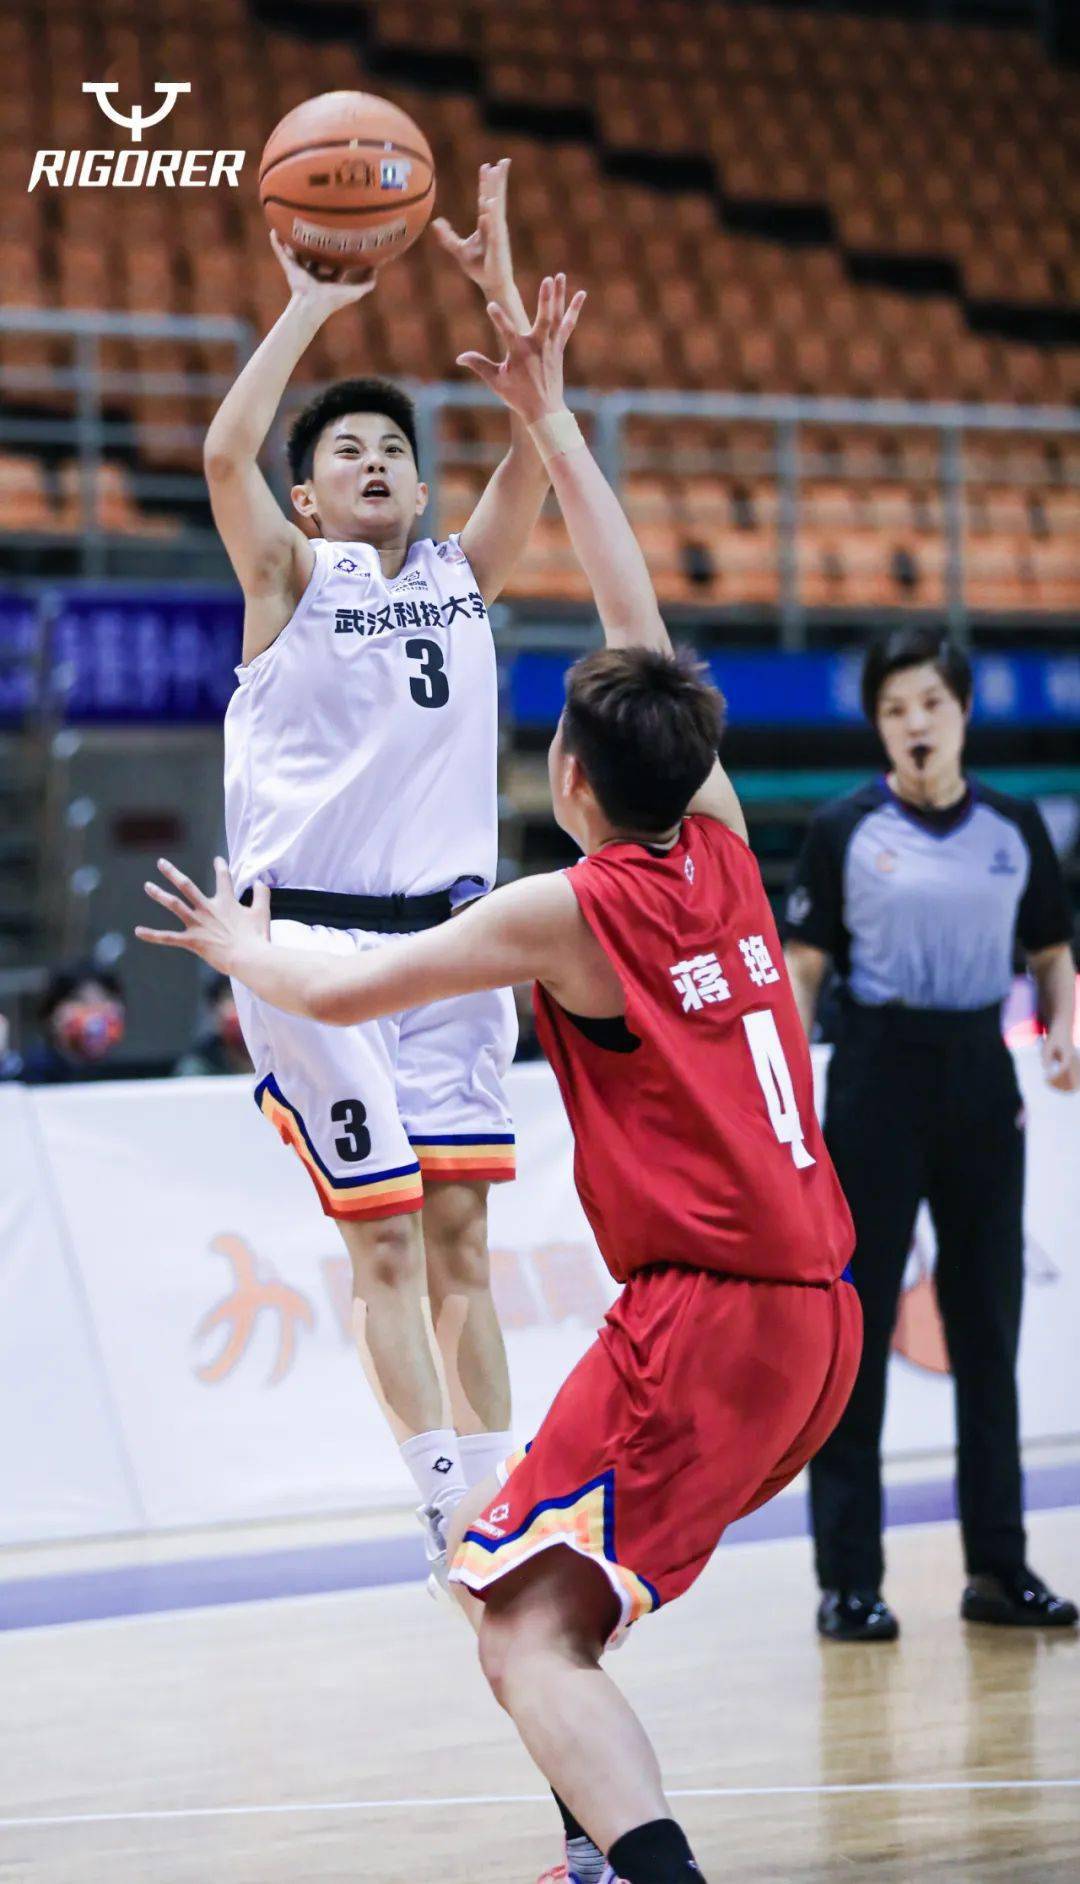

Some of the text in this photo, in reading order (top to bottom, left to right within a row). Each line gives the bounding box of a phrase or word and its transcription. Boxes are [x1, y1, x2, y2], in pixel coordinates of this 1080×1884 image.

[334, 591, 487, 636] 武汉科技大学
[405, 638, 450, 709] 3
[742, 1009, 817, 1170] 4
[330, 1098, 372, 1162] 3
